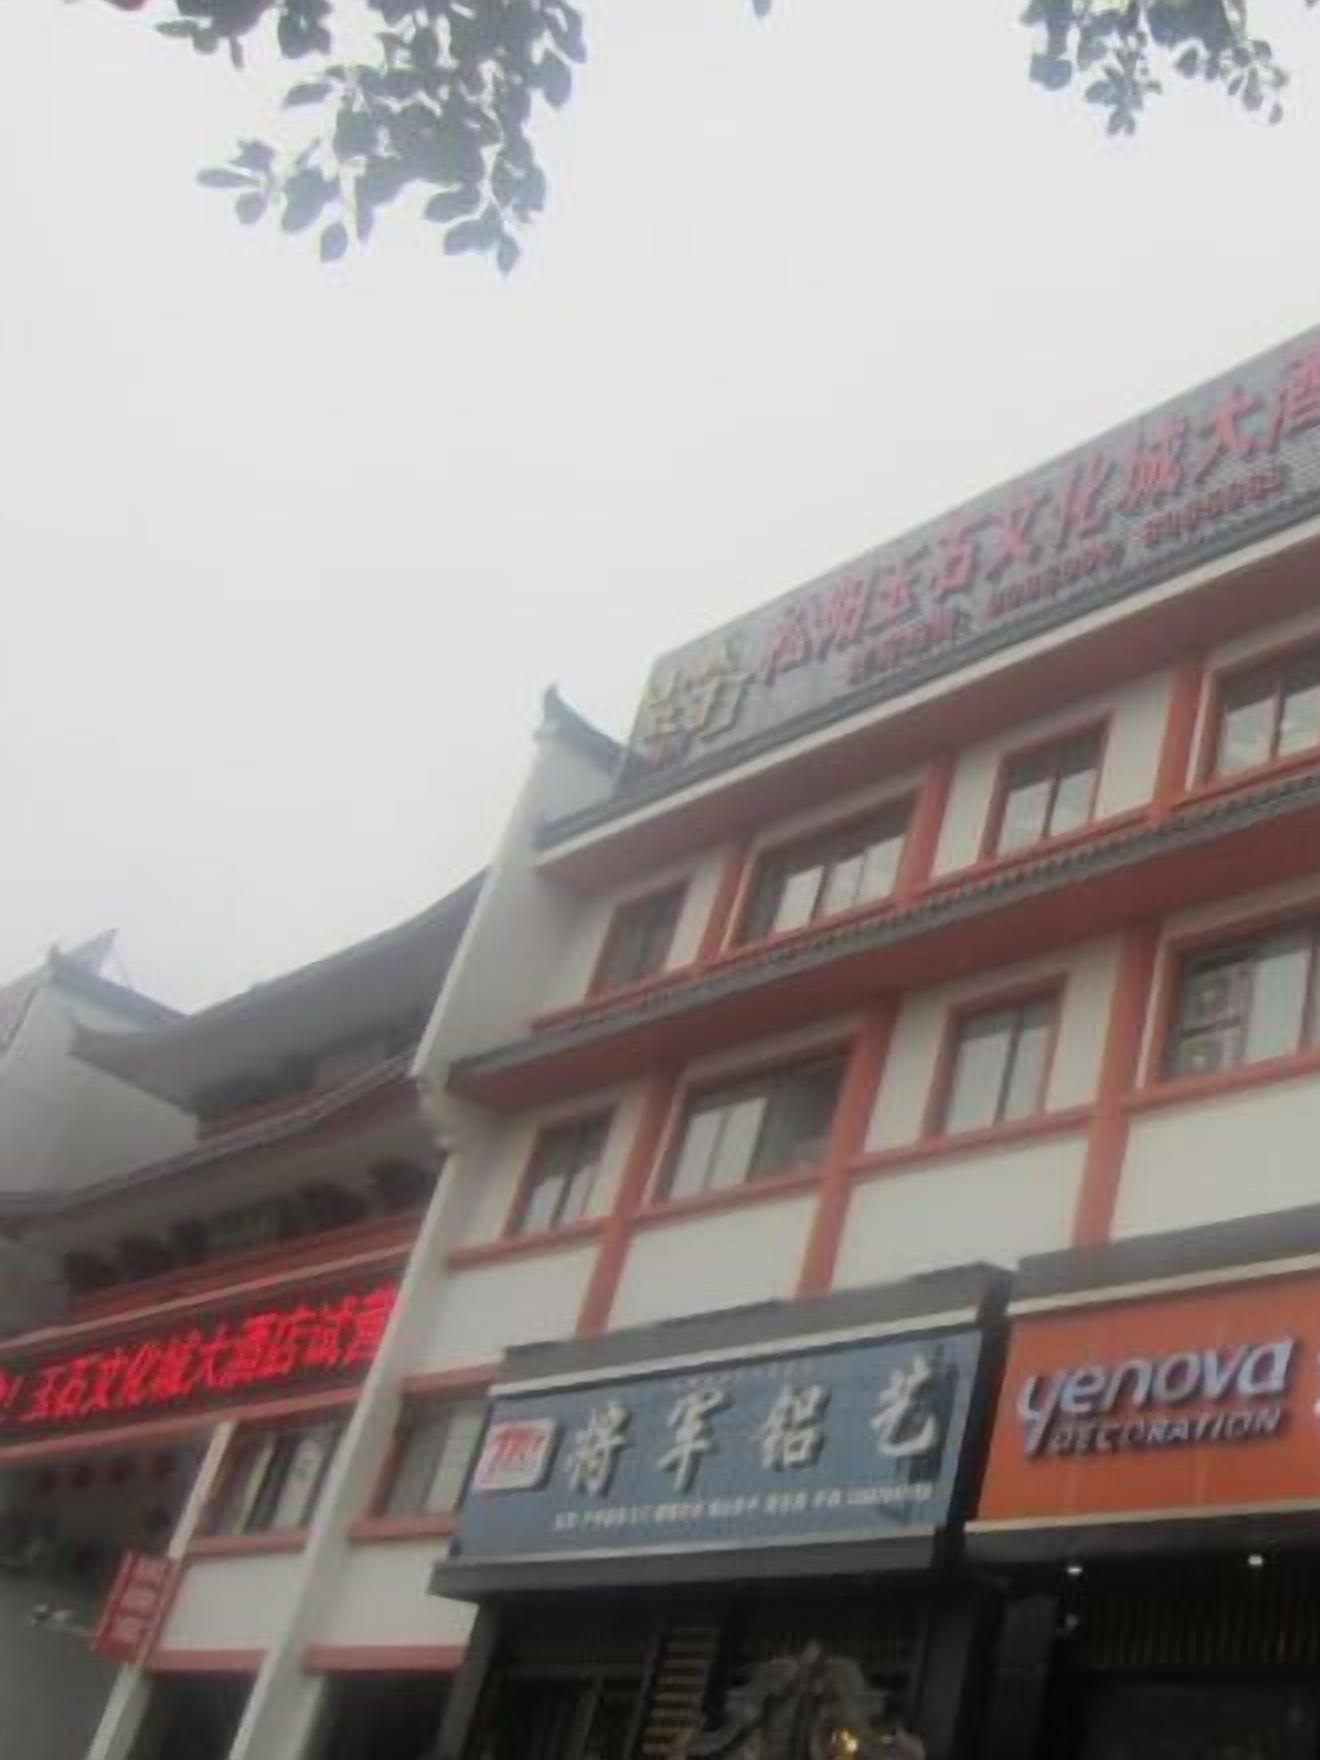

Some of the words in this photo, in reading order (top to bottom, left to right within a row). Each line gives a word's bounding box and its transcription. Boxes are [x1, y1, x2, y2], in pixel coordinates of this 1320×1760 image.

[567, 1348, 942, 1496] 将军铝艺
[1048, 1405, 1284, 1456] DECORATION
